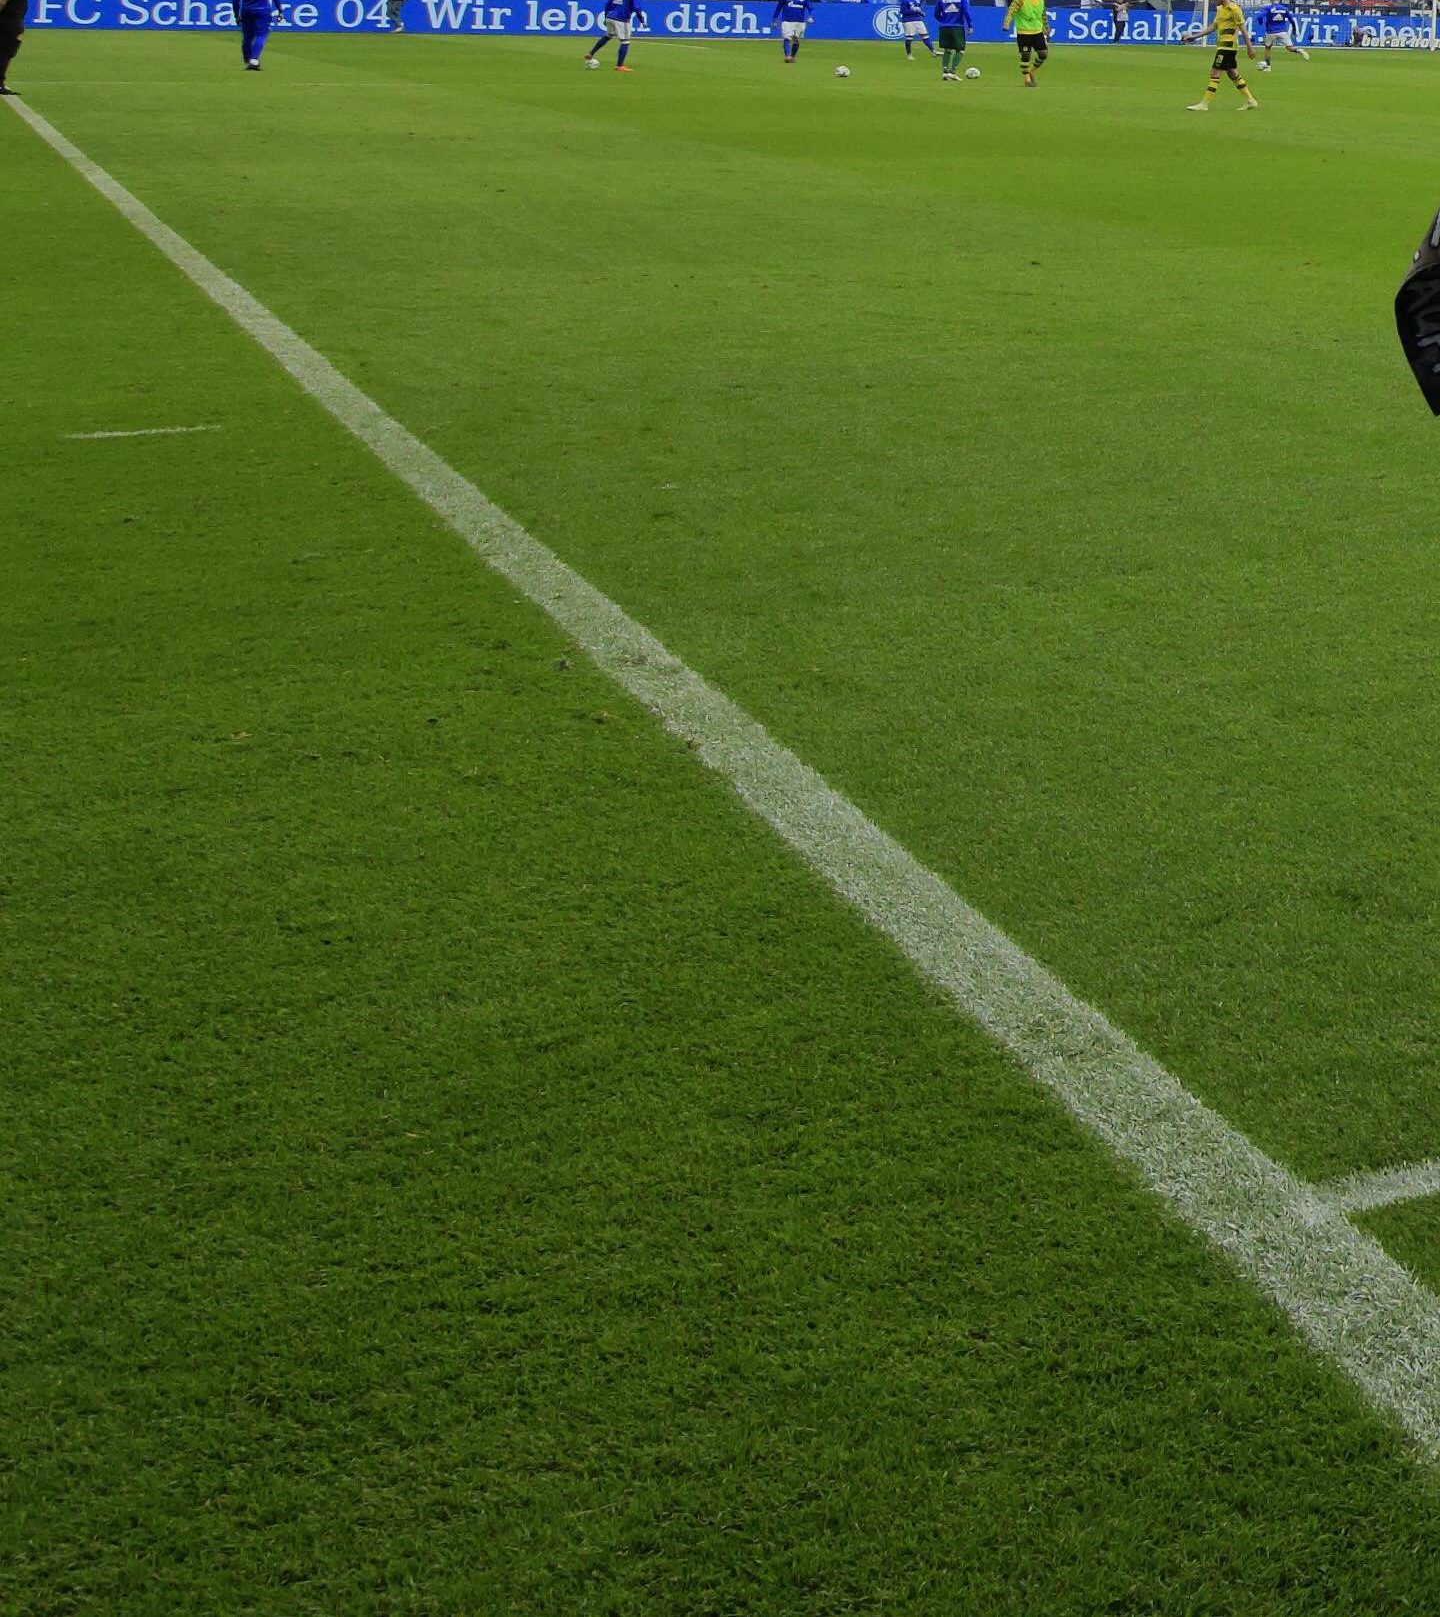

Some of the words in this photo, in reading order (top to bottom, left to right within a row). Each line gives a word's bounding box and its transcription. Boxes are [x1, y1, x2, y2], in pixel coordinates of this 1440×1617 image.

[525, 0, 649, 33] lebn
[665, 3, 771, 35] dich.
[1068, 8, 1202, 44] Schalke
